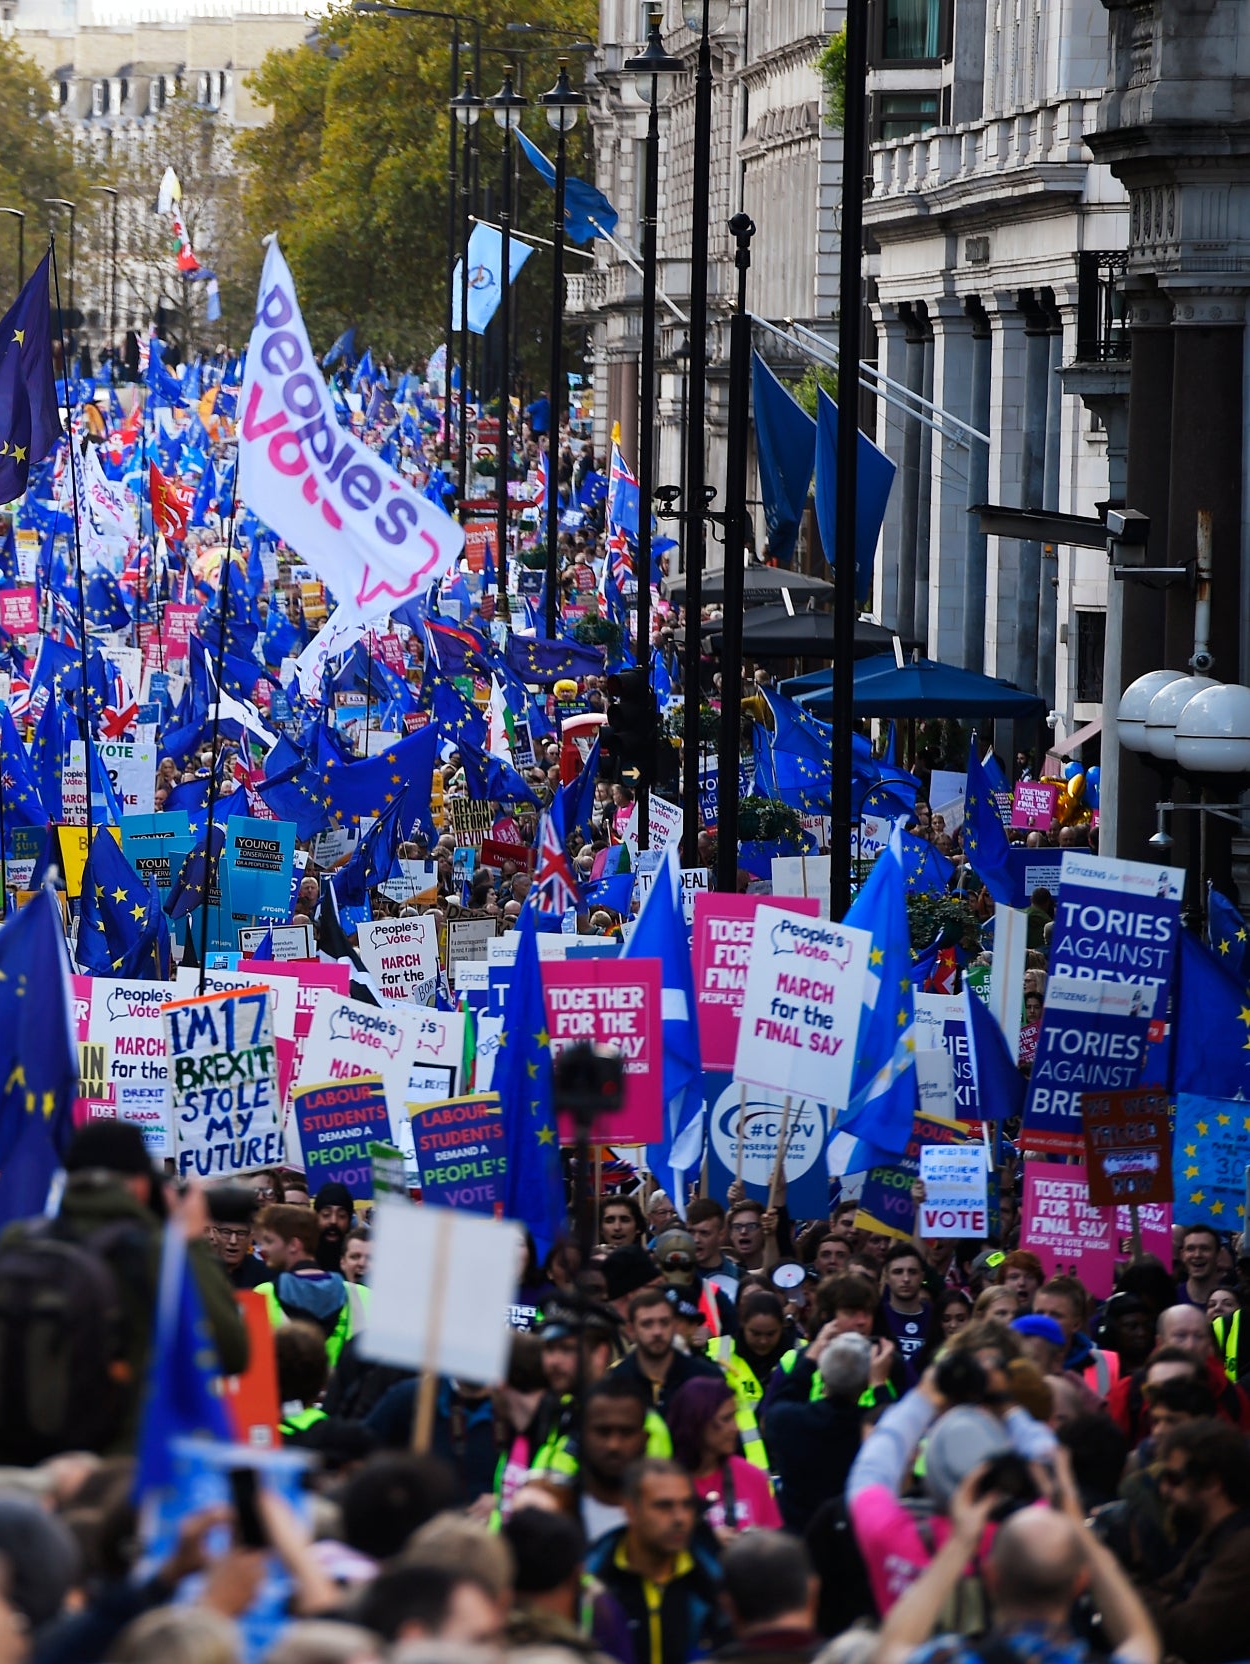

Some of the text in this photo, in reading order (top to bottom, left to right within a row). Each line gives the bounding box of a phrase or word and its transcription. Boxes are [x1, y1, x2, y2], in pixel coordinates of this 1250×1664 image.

[256, 284, 418, 546] People's
[242, 381, 343, 531] Vo
[65, 778, 83, 786] Vote
[452, 798, 490, 815] REMAIN
[454, 812, 492, 831] REFORM
[649, 820, 670, 837] ARCH
[238, 838, 278, 851] YOUNG
[238, 850, 285, 861] CONSERVATIVES
[139, 859, 170, 869] YOUN
[374, 921, 419, 936] People's
[707, 918, 755, 943] TOGE
[1061, 902, 1173, 943] TORIES
[385, 934, 412, 945] Vote
[779, 919, 844, 949] People's
[380, 953, 421, 970] MARCH
[492, 949, 518, 958] CITIZE
[714, 943, 752, 966] FOR
[793, 940, 829, 962] Vote
[1054, 934, 1171, 970] AGAINST
[381, 969, 425, 985] for the
[459, 973, 489, 982] CITIZE
[705, 967, 748, 990] FINA
[114, 986, 173, 1006] People's
[380, 987, 409, 999] INAL
[547, 986, 646, 1011] TOGETHER
[776, 972, 835, 1005] MARCH
[127, 1003, 161, 1019] Vote
[338, 1005, 397, 1036] People's
[770, 997, 833, 1030] for the
[166, 1005, 219, 1056] I'M
[555, 1011, 638, 1036] FOR THE
[114, 1036, 167, 1057] MARCH
[349, 1026, 382, 1049] Vote
[754, 1017, 844, 1057] FINAL SAY
[1043, 1026, 1143, 1062] TORIES
[111, 1059, 168, 1079] for the
[174, 1045, 275, 1094] BREXIT
[1036, 1058, 1138, 1088] AGAINST
[122, 1087, 165, 1099] BREXIT
[181, 1077, 271, 1123] STOLE
[304, 1083, 372, 1112] LABOUR
[1030, 1087, 1084, 1118] BRE
[89, 1104, 117, 1120] TOGE
[124, 1110, 161, 1121] CHAOS
[302, 1103, 386, 1133] STUDENTS
[420, 1102, 489, 1129] LABOUR
[205, 1110, 255, 1142] MY
[317, 1125, 374, 1144] DEMAND A
[1087, 1121, 1159, 1147] TRICKED
[419, 1123, 504, 1152] STUDENTS
[179, 1129, 284, 1178] FUTURE!
[433, 1143, 490, 1162] DEMAND A
[924, 1148, 935, 1156] WE
[938, 1148, 957, 1156] NEED
[328, 1167, 374, 1187] VOT
[424, 1156, 507, 1187] PEOPLE'S
[924, 1165, 938, 1174] THE
[1214, 1157, 1246, 1178] 30
[870, 1167, 916, 1192] PEOP
[1033, 1179, 1090, 1201] TOGETH
[1112, 1175, 1154, 1196] NOW
[444, 1183, 496, 1207] VOTE
[1037, 1198, 1102, 1220] FOR THE
[1135, 1205, 1164, 1223] SAY
[924, 1209, 986, 1232] VOTE
[1030, 1216, 1109, 1239] FINAL SAY
[1025, 1234, 1111, 1251] PEOPLE'S VOTE MARCH
